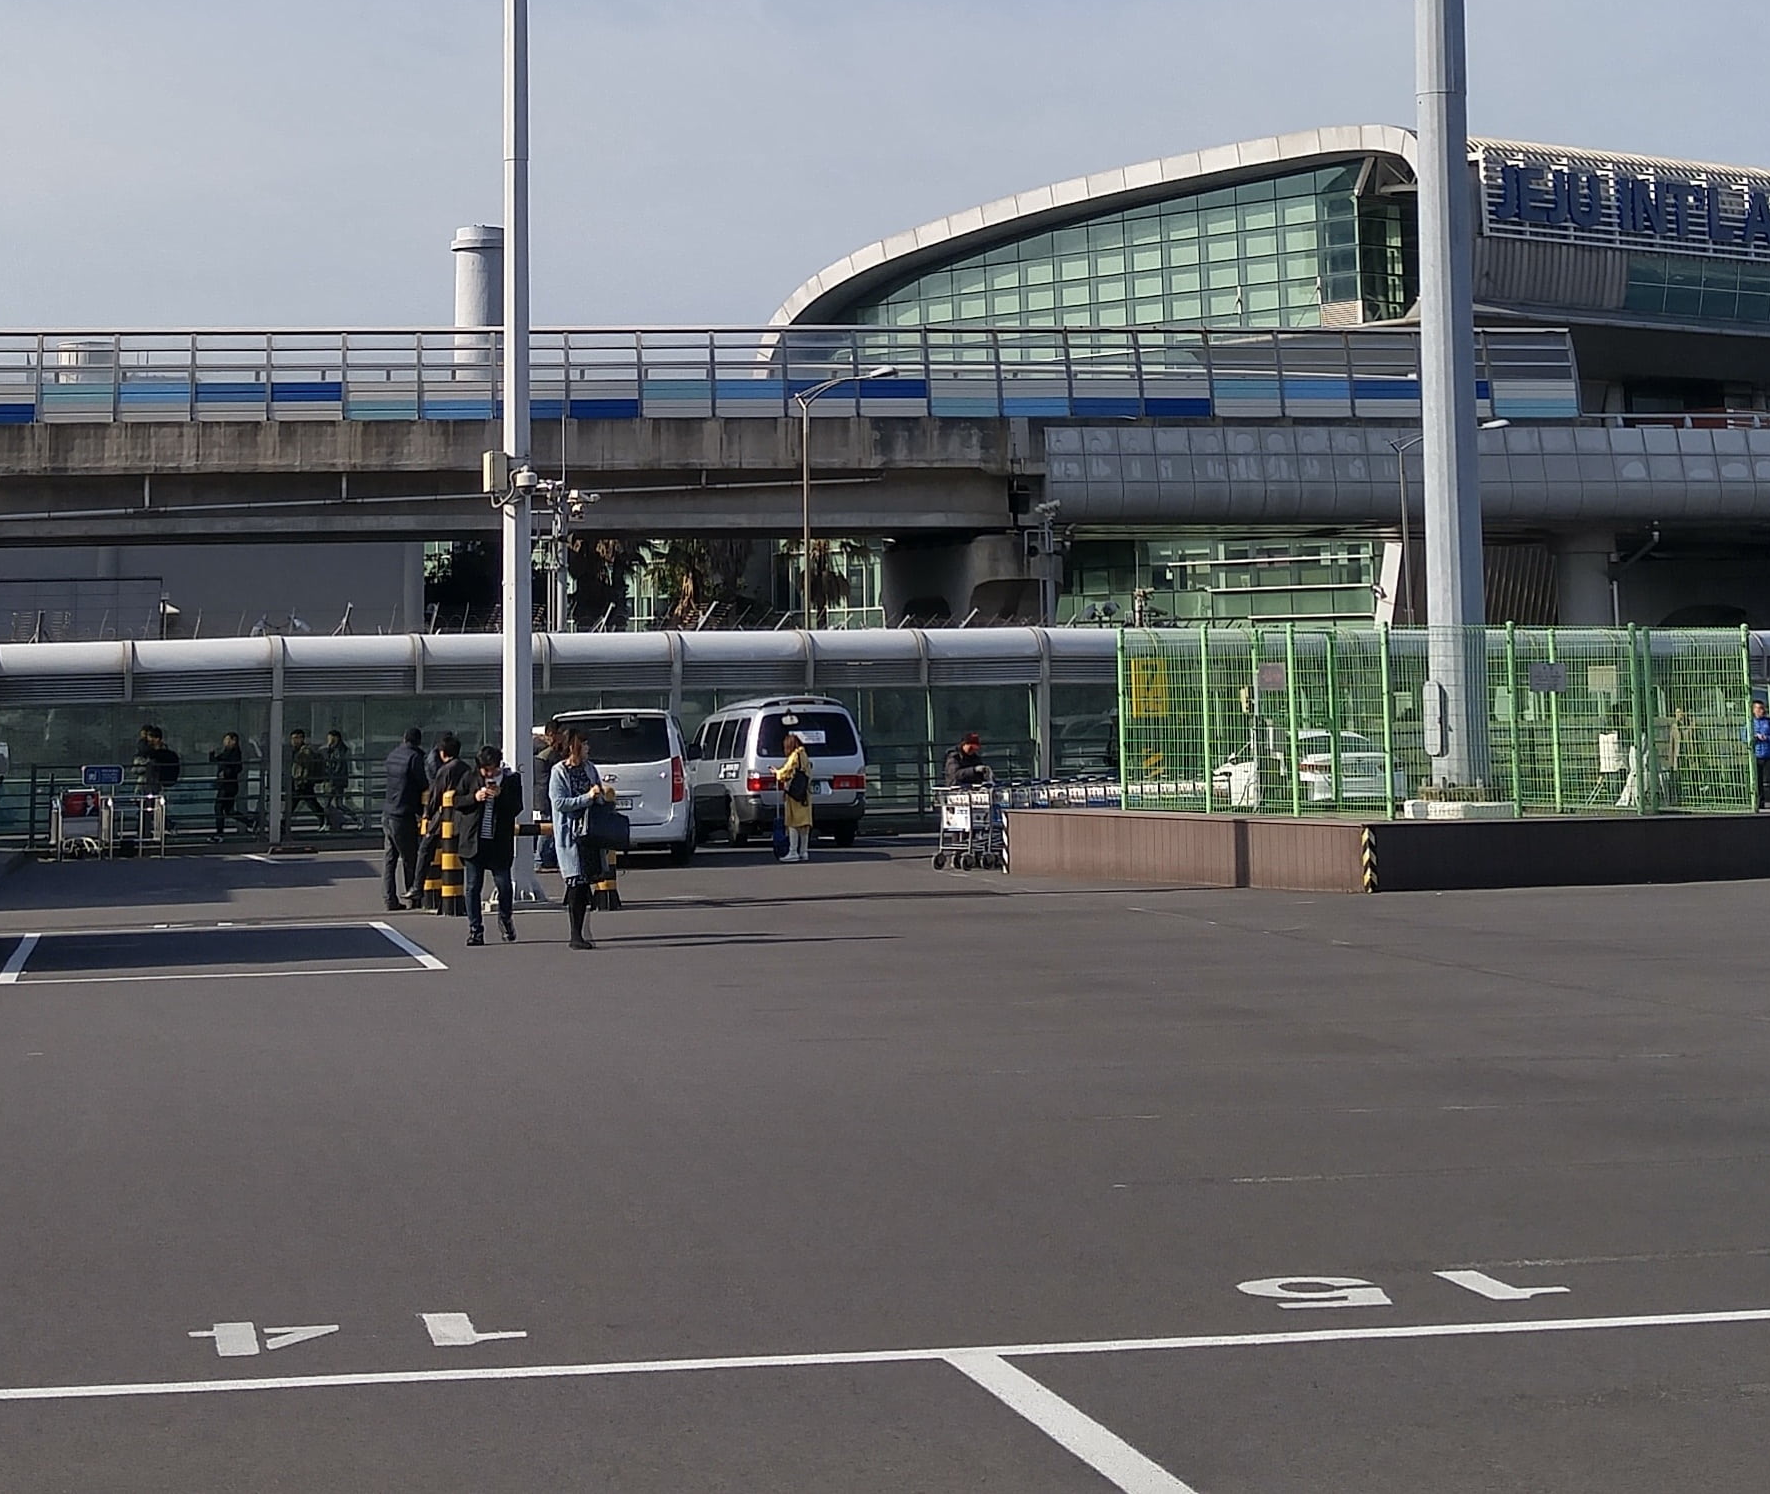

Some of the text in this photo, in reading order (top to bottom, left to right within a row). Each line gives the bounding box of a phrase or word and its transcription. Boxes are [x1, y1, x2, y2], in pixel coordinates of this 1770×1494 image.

[1496, 165, 1609, 228] JEJU
[1620, 177, 1736, 243] INT'L
[1234, 1267, 1570, 1307] 15
[189, 1312, 526, 1356] 14
